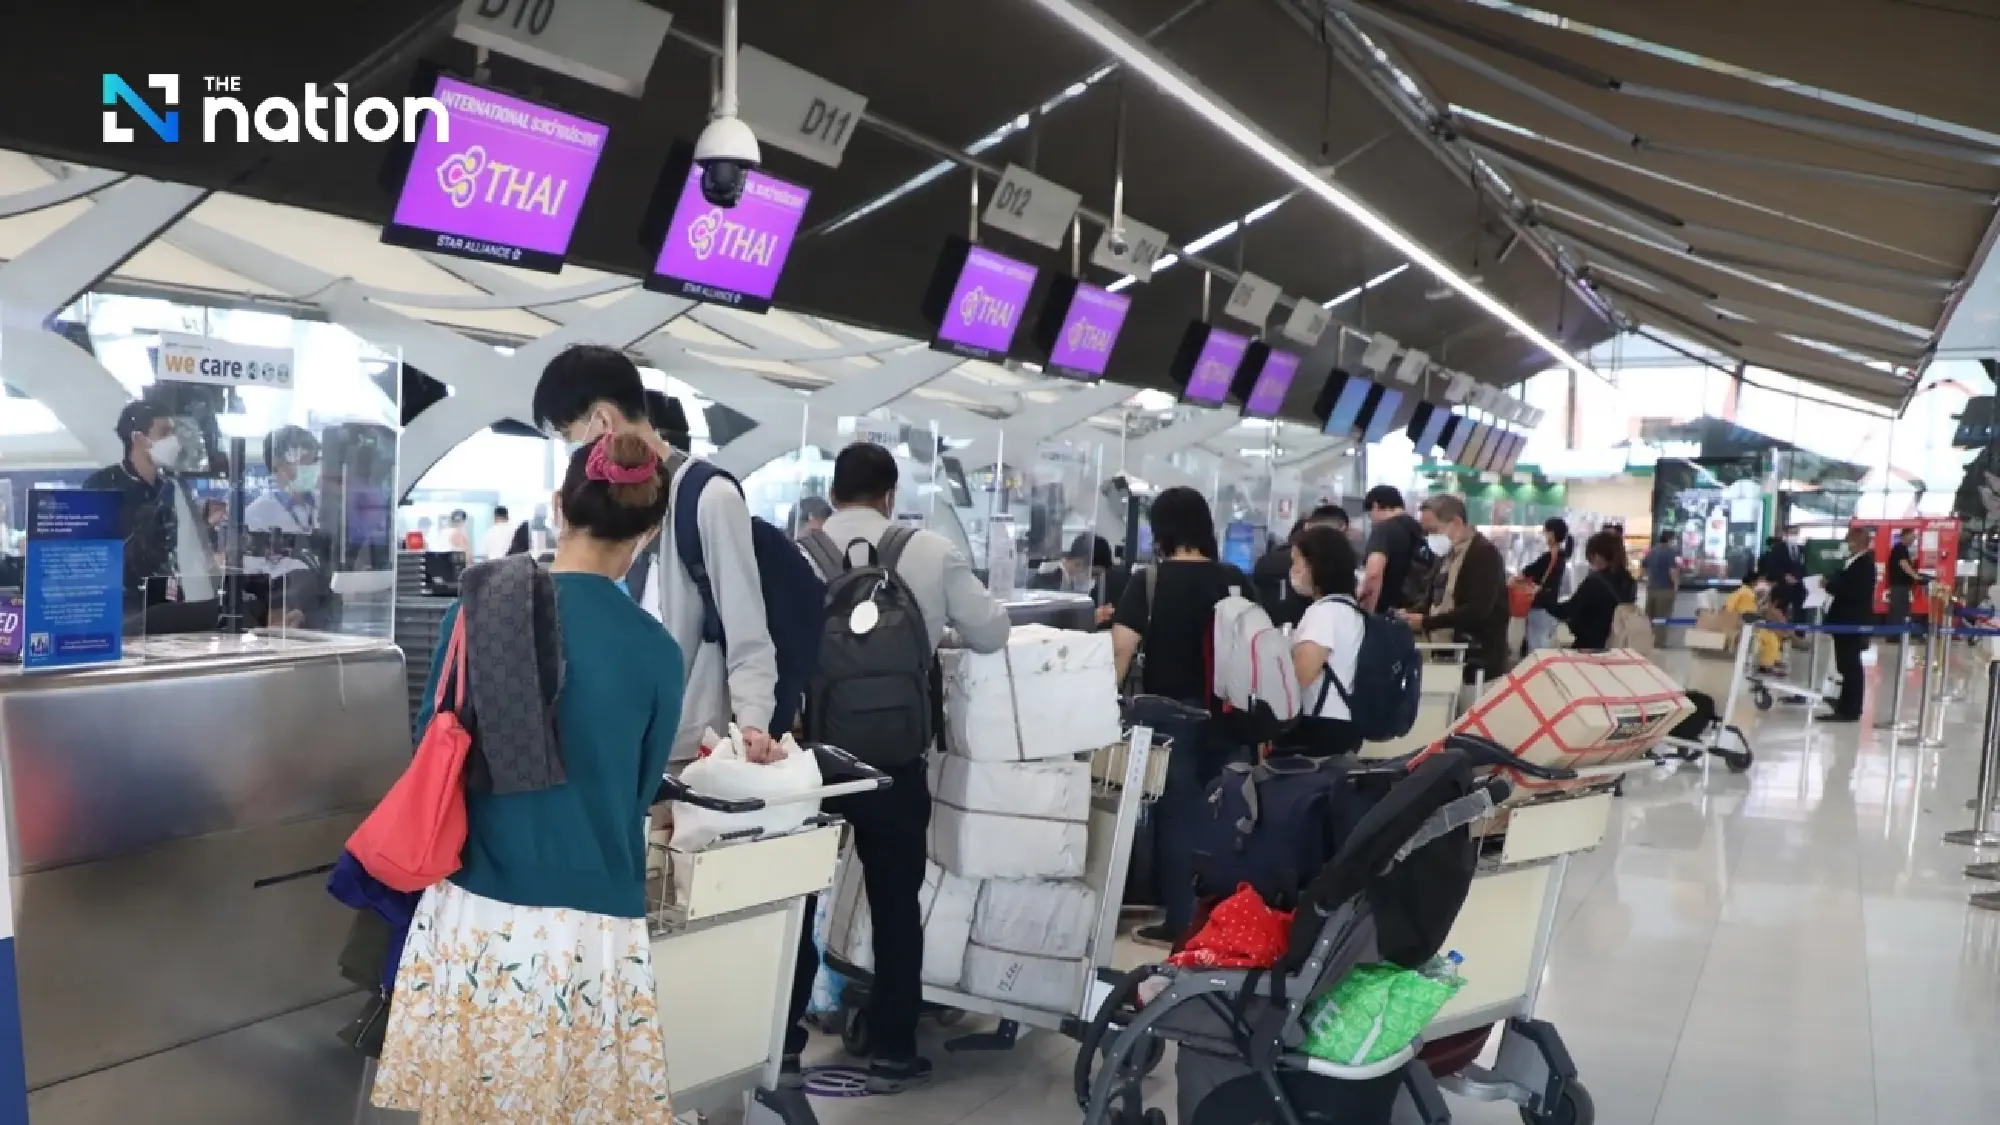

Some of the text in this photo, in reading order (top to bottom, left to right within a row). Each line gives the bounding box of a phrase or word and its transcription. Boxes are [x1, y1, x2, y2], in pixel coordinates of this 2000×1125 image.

[440, 89, 528, 129] INTERNATIONAL
[801, 97, 852, 146] D11
[484, 160, 569, 216] THAI
[996, 181, 1033, 218] D12
[436, 234, 512, 259] STAR ALLIANCE
[718, 220, 779, 267] THAI
[978, 298, 1016, 329] THAI
[165, 353, 242, 380] we care
